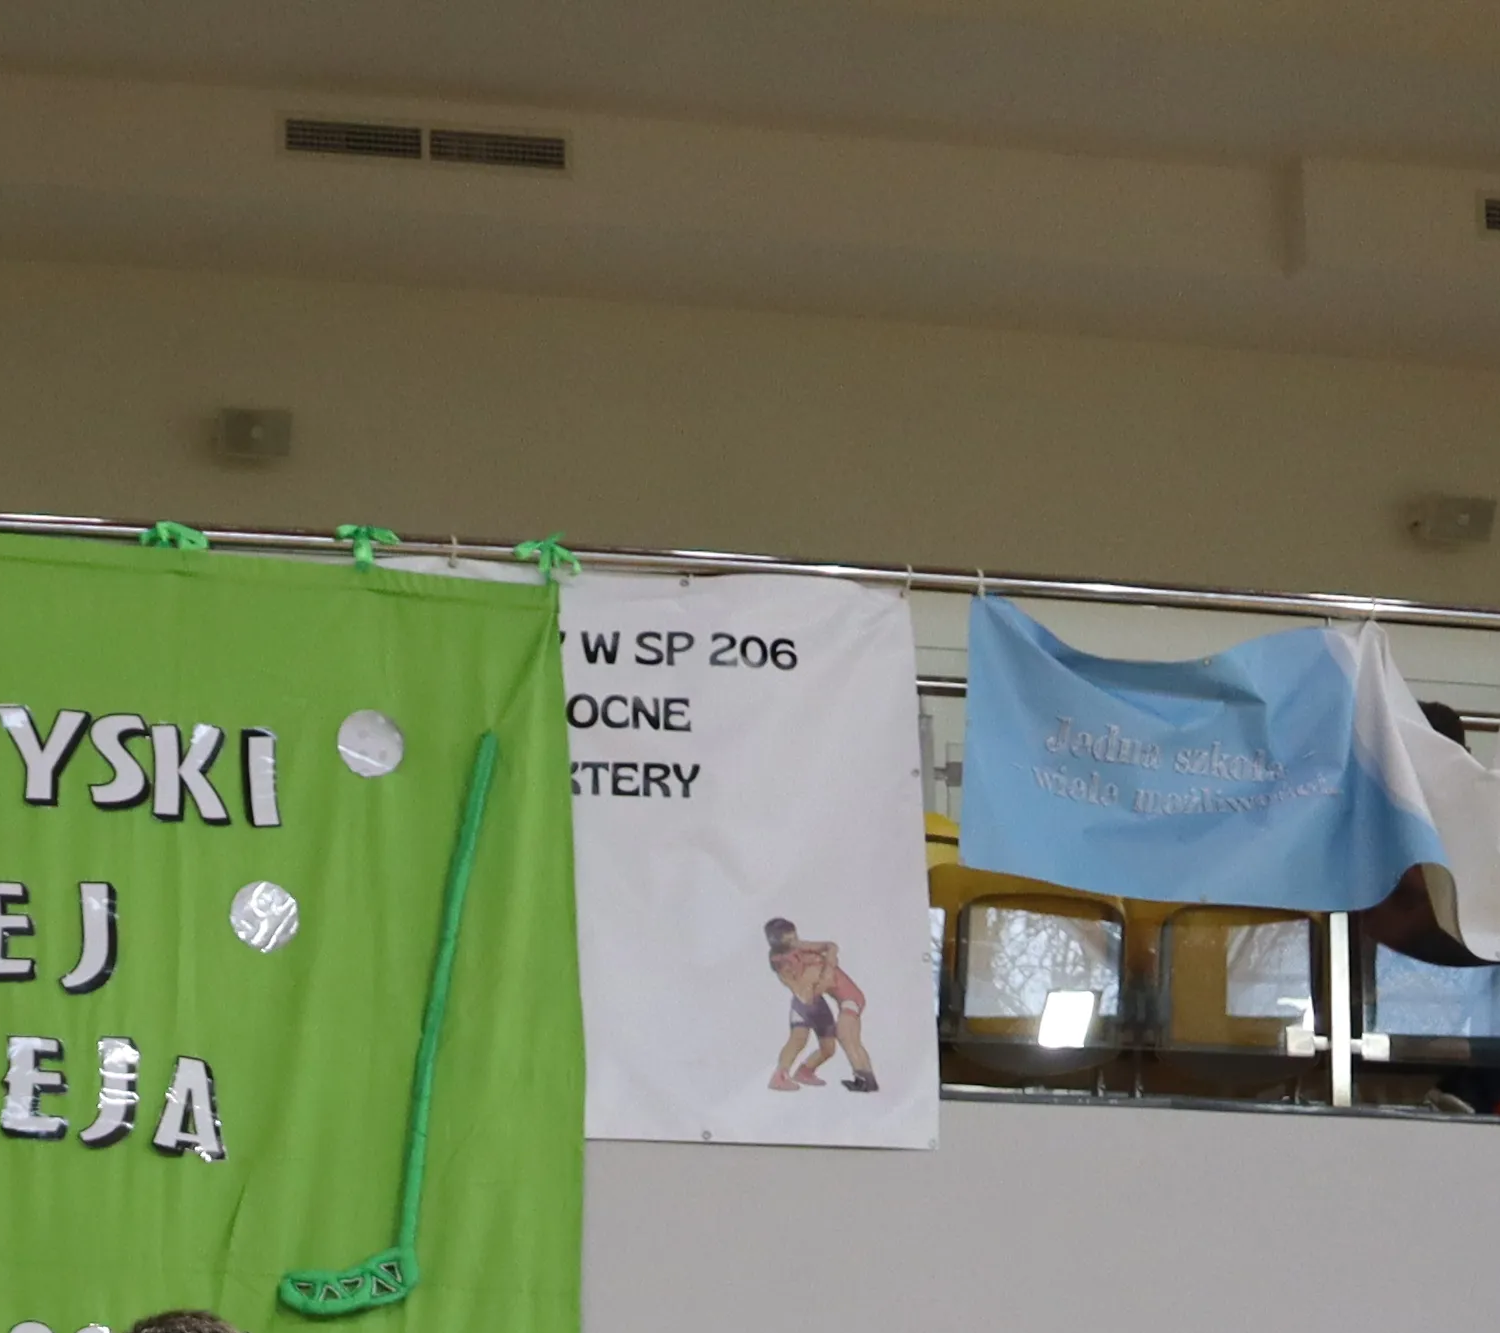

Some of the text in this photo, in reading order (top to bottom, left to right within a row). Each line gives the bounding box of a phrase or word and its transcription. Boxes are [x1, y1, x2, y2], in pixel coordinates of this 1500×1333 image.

[580, 630, 798, 671] W SP 206
